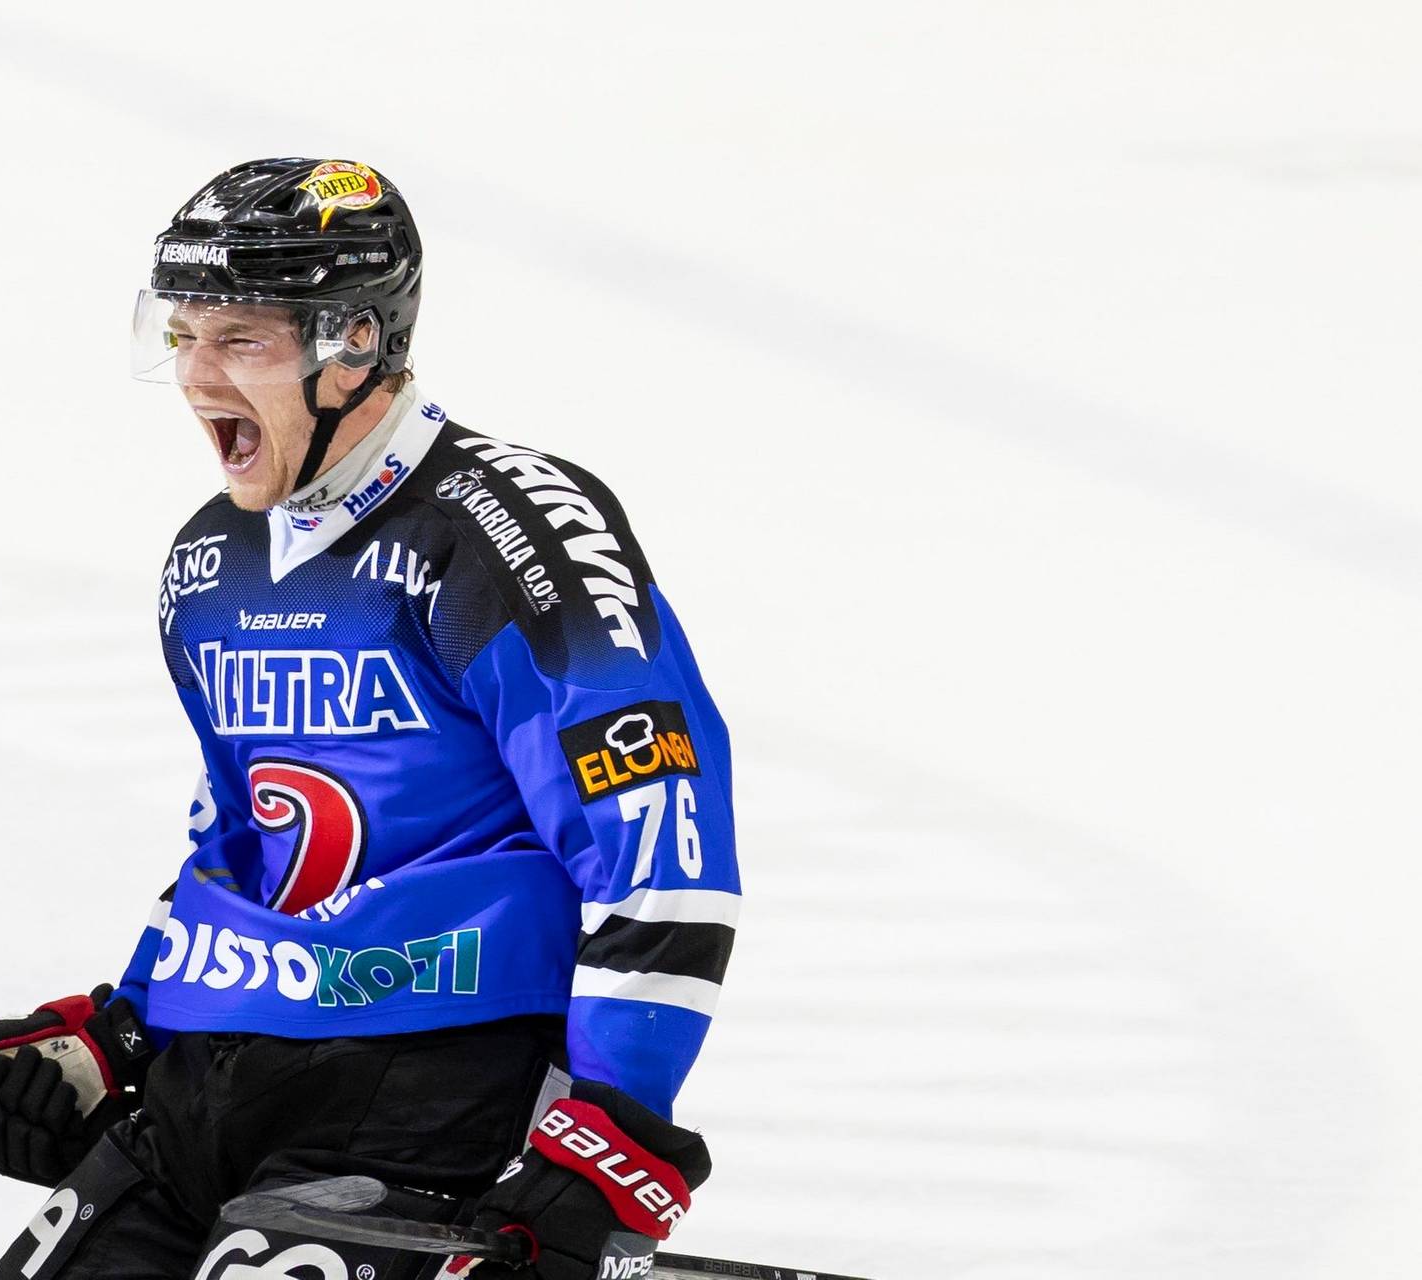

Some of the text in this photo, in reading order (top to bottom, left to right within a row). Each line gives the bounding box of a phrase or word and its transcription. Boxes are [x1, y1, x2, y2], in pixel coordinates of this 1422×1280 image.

[161, 243, 229, 266] KESKIMAA
[453, 437, 648, 663] HARVIA
[462, 488, 536, 571] KARJALA
[523, 564, 562, 612] 0.0%
[250, 613, 327, 630] BAUER
[576, 731, 697, 794] ELONEN
[617, 778, 703, 888] 76
[150, 917, 481, 1006] OISTOKOTI
[537, 1109, 687, 1233] BAUER
